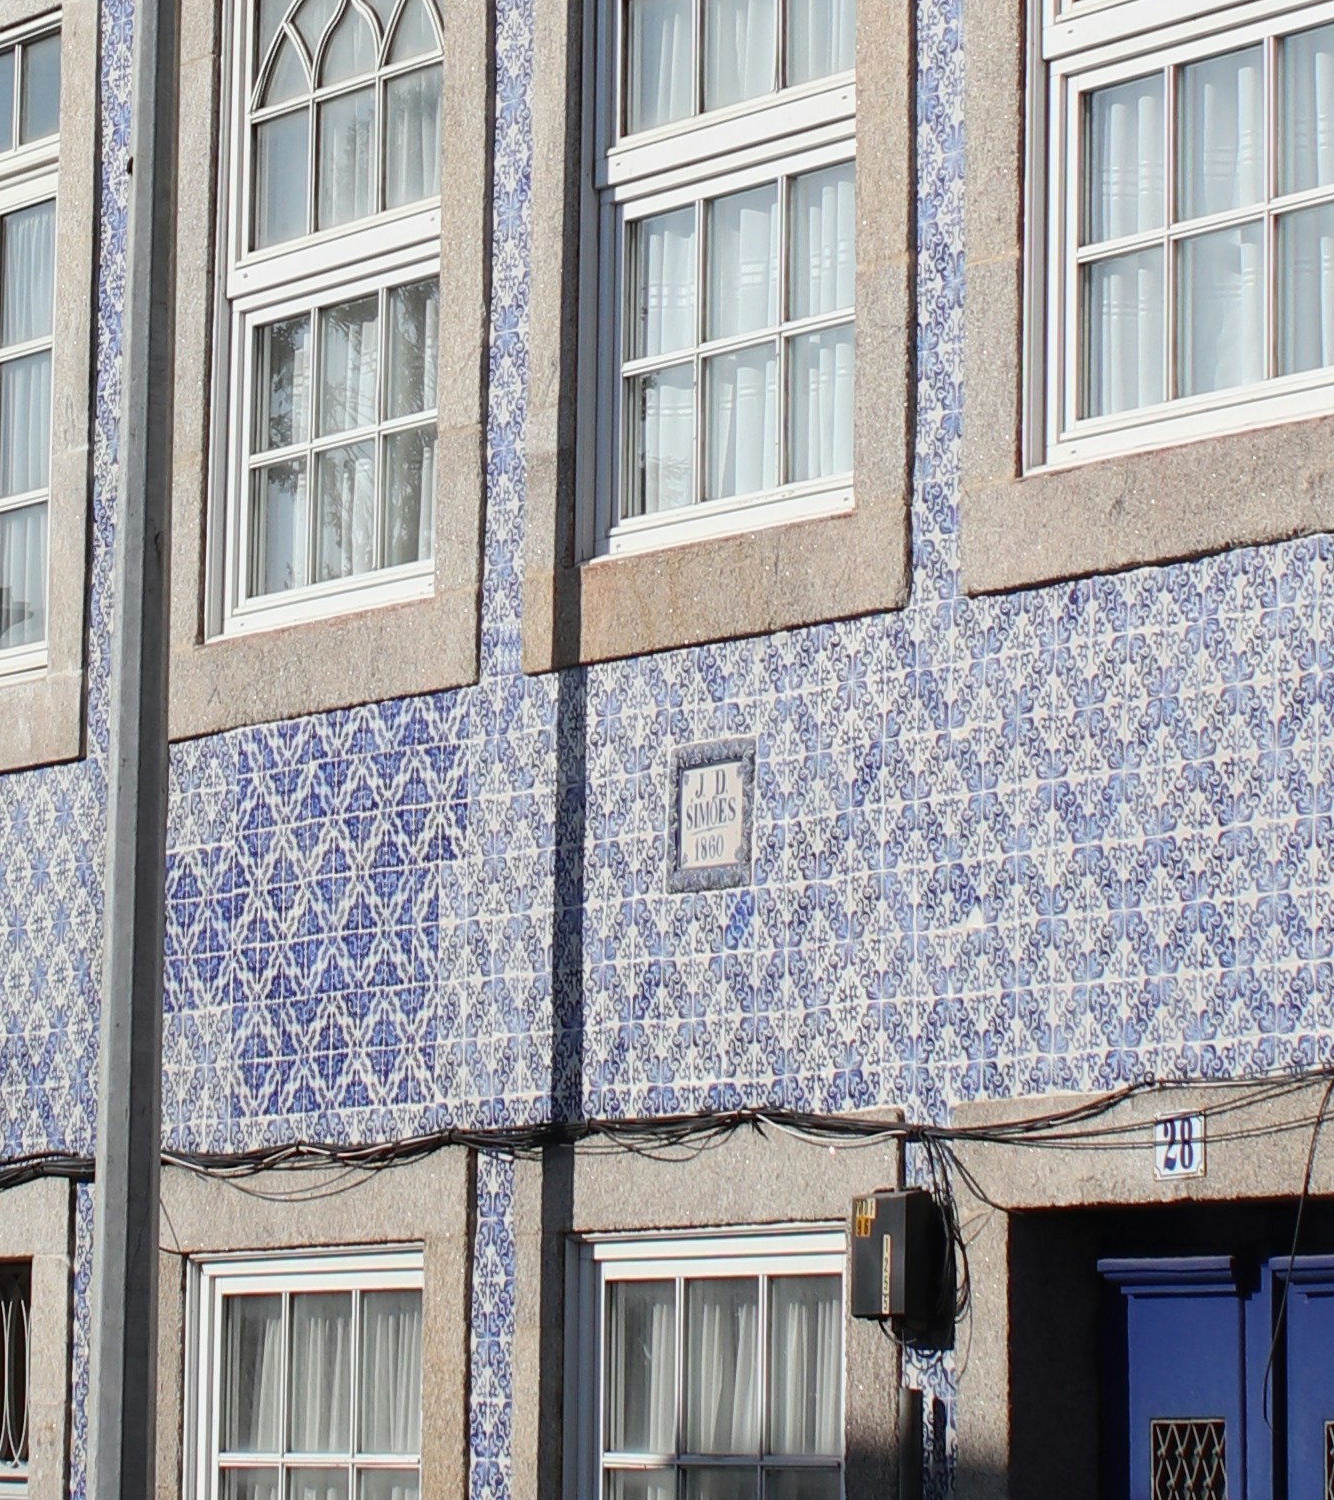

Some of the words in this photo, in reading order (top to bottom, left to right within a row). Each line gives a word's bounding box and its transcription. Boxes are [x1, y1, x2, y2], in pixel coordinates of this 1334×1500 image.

[695, 773, 706, 798] J.
[716, 768, 729, 795] D.
[686, 796, 736, 830] SIMÕES
[695, 834, 724, 862] 1860
[1163, 1116, 1194, 1171] 28
